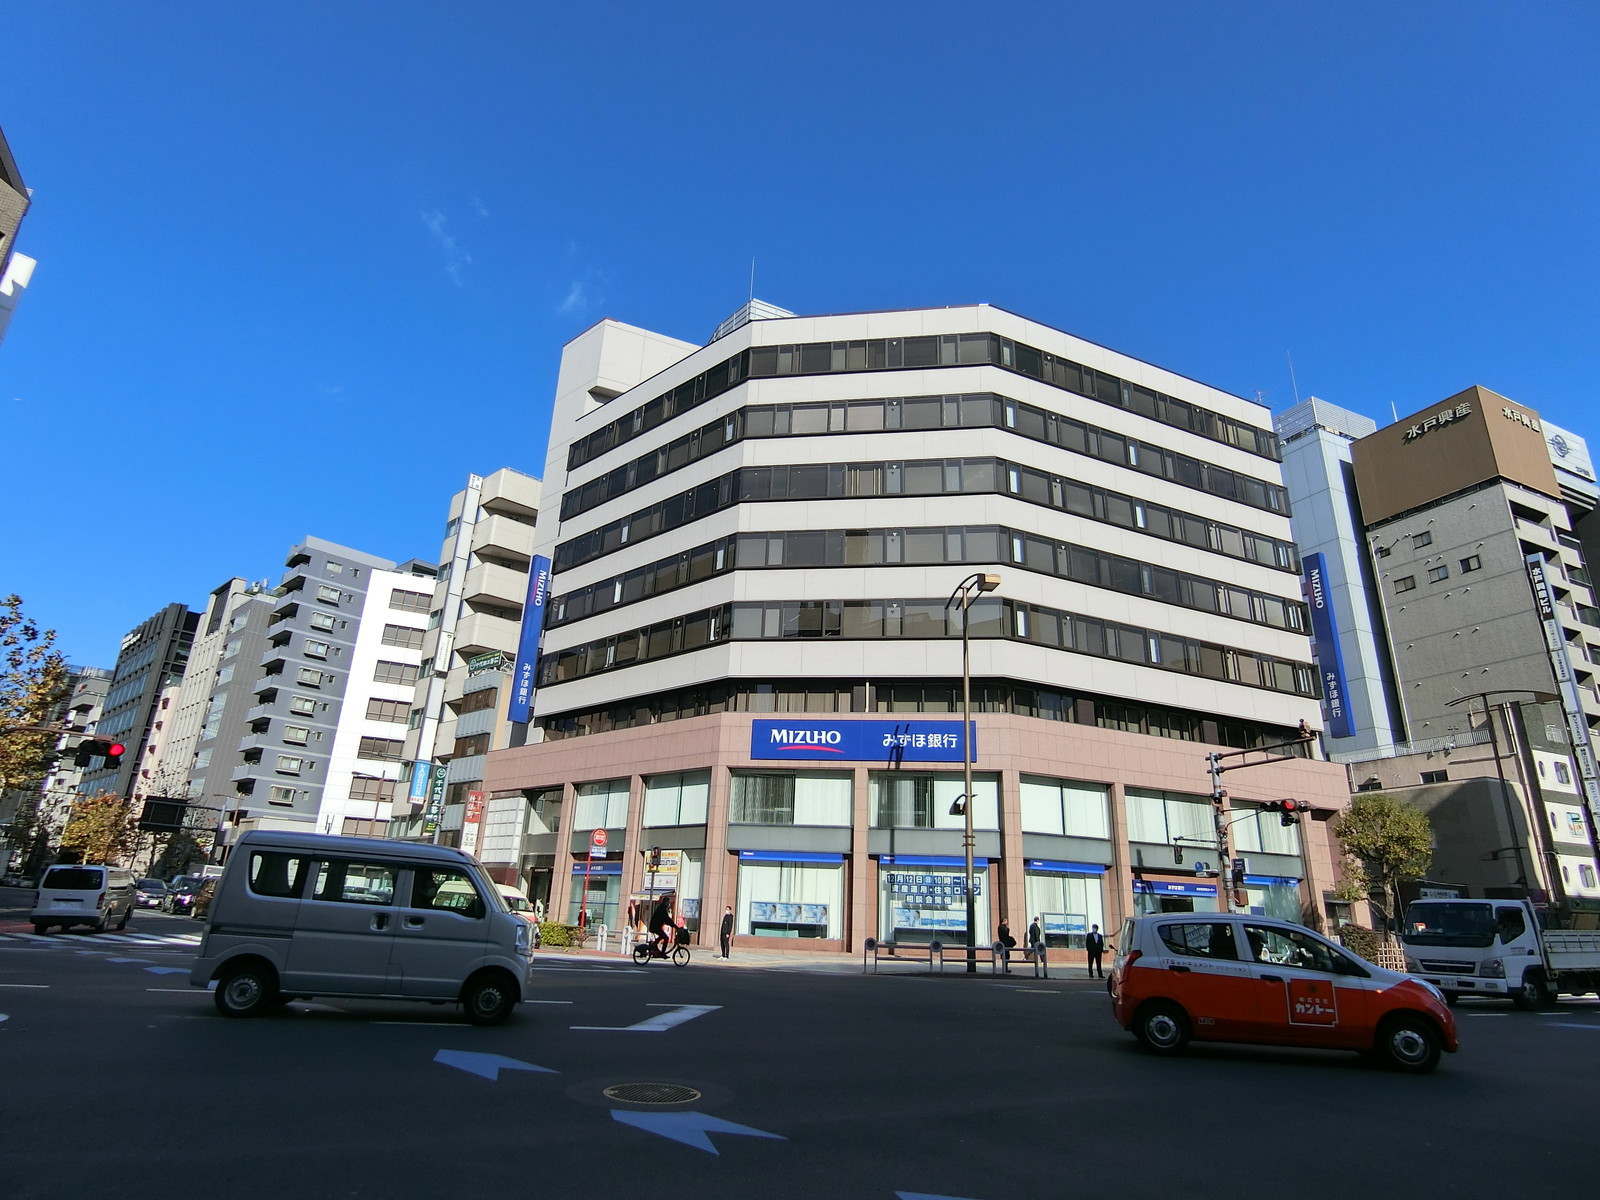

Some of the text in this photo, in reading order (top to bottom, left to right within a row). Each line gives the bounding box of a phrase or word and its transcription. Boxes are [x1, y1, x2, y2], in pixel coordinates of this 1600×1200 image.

[1406, 402, 1472, 438] 水戸興産
[1502, 406, 1541, 432] 水戸興産
[534, 569, 547, 607] MIZUHO
[1310, 568, 1324, 609] MIZUHO
[1532, 567, 1552, 614] 水戸興産ビル
[518, 662, 532, 705] みずほ銀行
[1326, 672, 1342, 718] みずほ銀行
[770, 729, 842, 744] MIZUHO
[882, 733, 958, 749] みずほ銀行
[415, 763, 427, 796] LAWSON
[1295, 1003, 1335, 1015] カントー
